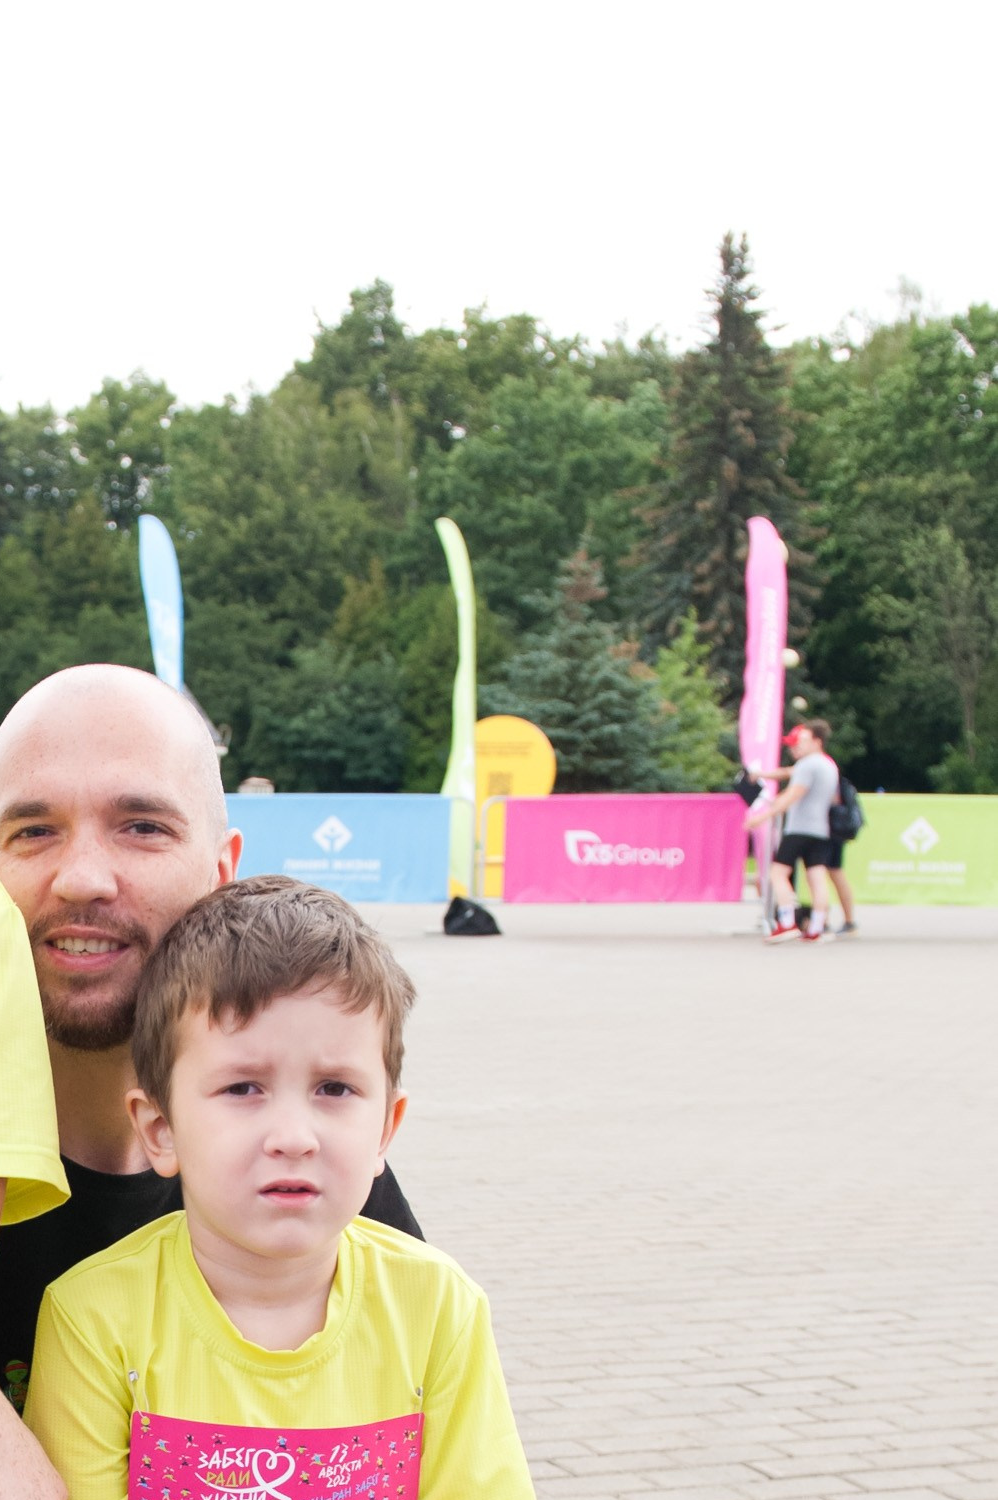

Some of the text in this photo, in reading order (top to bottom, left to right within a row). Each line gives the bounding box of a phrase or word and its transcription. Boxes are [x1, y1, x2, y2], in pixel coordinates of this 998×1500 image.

[197, 1446, 257, 1470] ЗАБЕГ
[329, 1443, 349, 1463] 13
[205, 1470, 251, 1488] РАДИ
[317, 1458, 362, 1480] АВГУСТА
[326, 1472, 351, 1489] 2023
[355, 1472, 380, 1496] ЗАБЕГ
